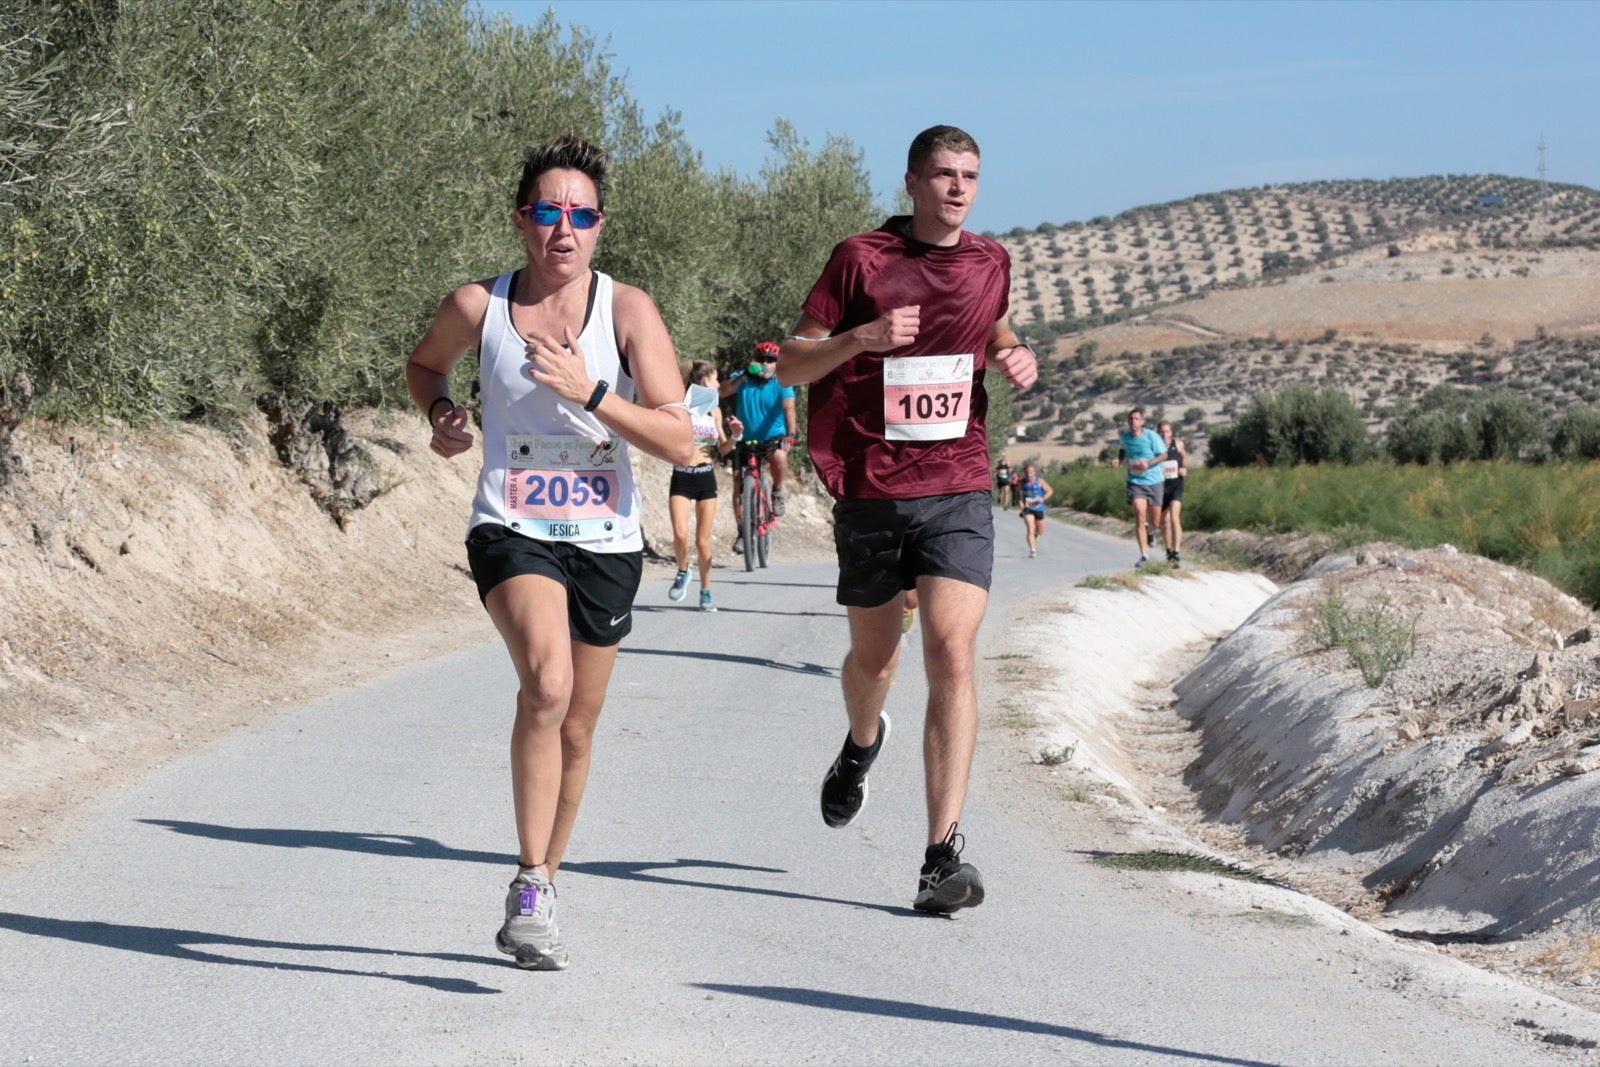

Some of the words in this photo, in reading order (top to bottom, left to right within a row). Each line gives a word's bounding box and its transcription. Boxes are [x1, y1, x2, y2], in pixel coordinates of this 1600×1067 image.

[899, 392, 963, 419] 1037
[693, 465, 713, 474] PRO
[510, 483, 518, 509] MASTER
[525, 474, 610, 507] 2059
[548, 524, 580, 537] JESICA
